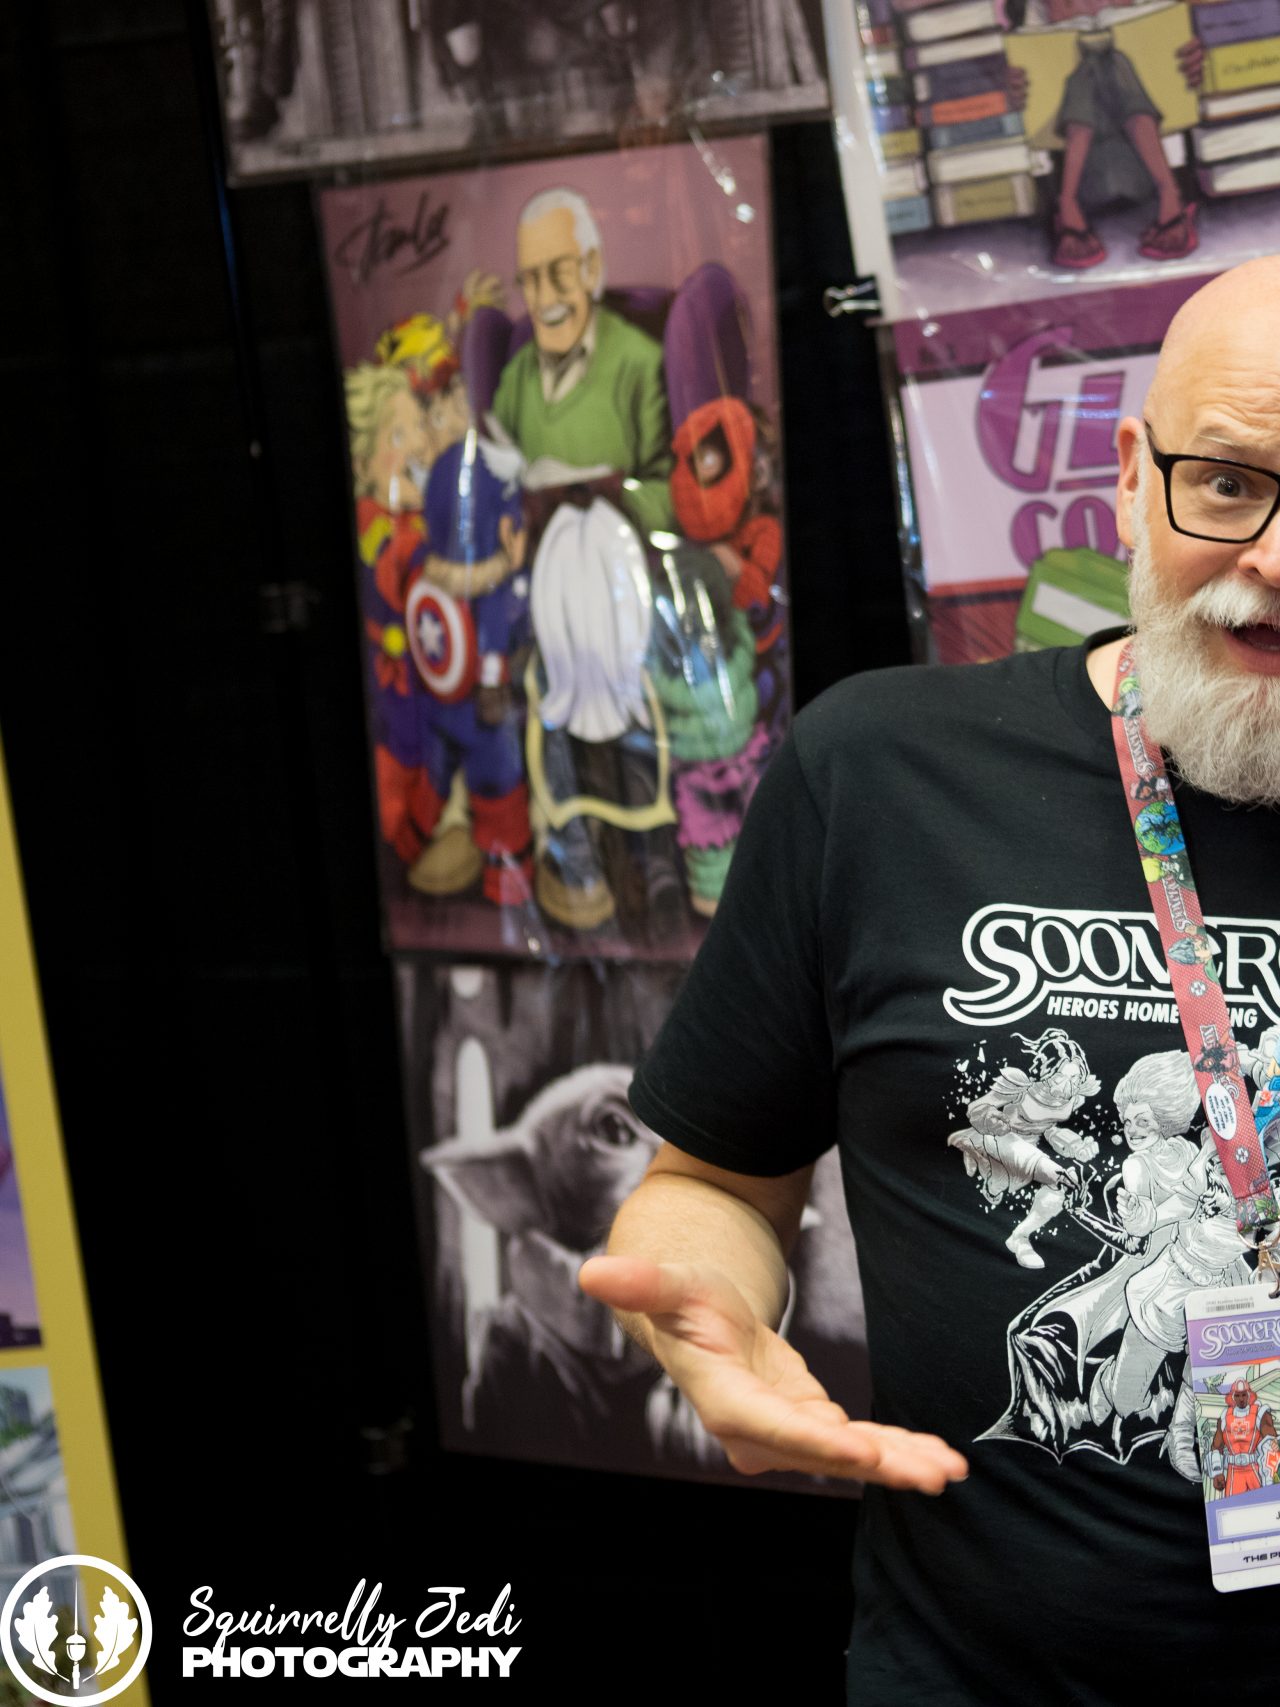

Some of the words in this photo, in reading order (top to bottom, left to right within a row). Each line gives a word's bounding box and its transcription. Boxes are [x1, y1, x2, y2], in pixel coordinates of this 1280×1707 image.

[1046, 996, 1119, 1020] HEROES
[1124, 1000, 1258, 1029] HOMENG
[1242, 1553, 1268, 1564] THE
